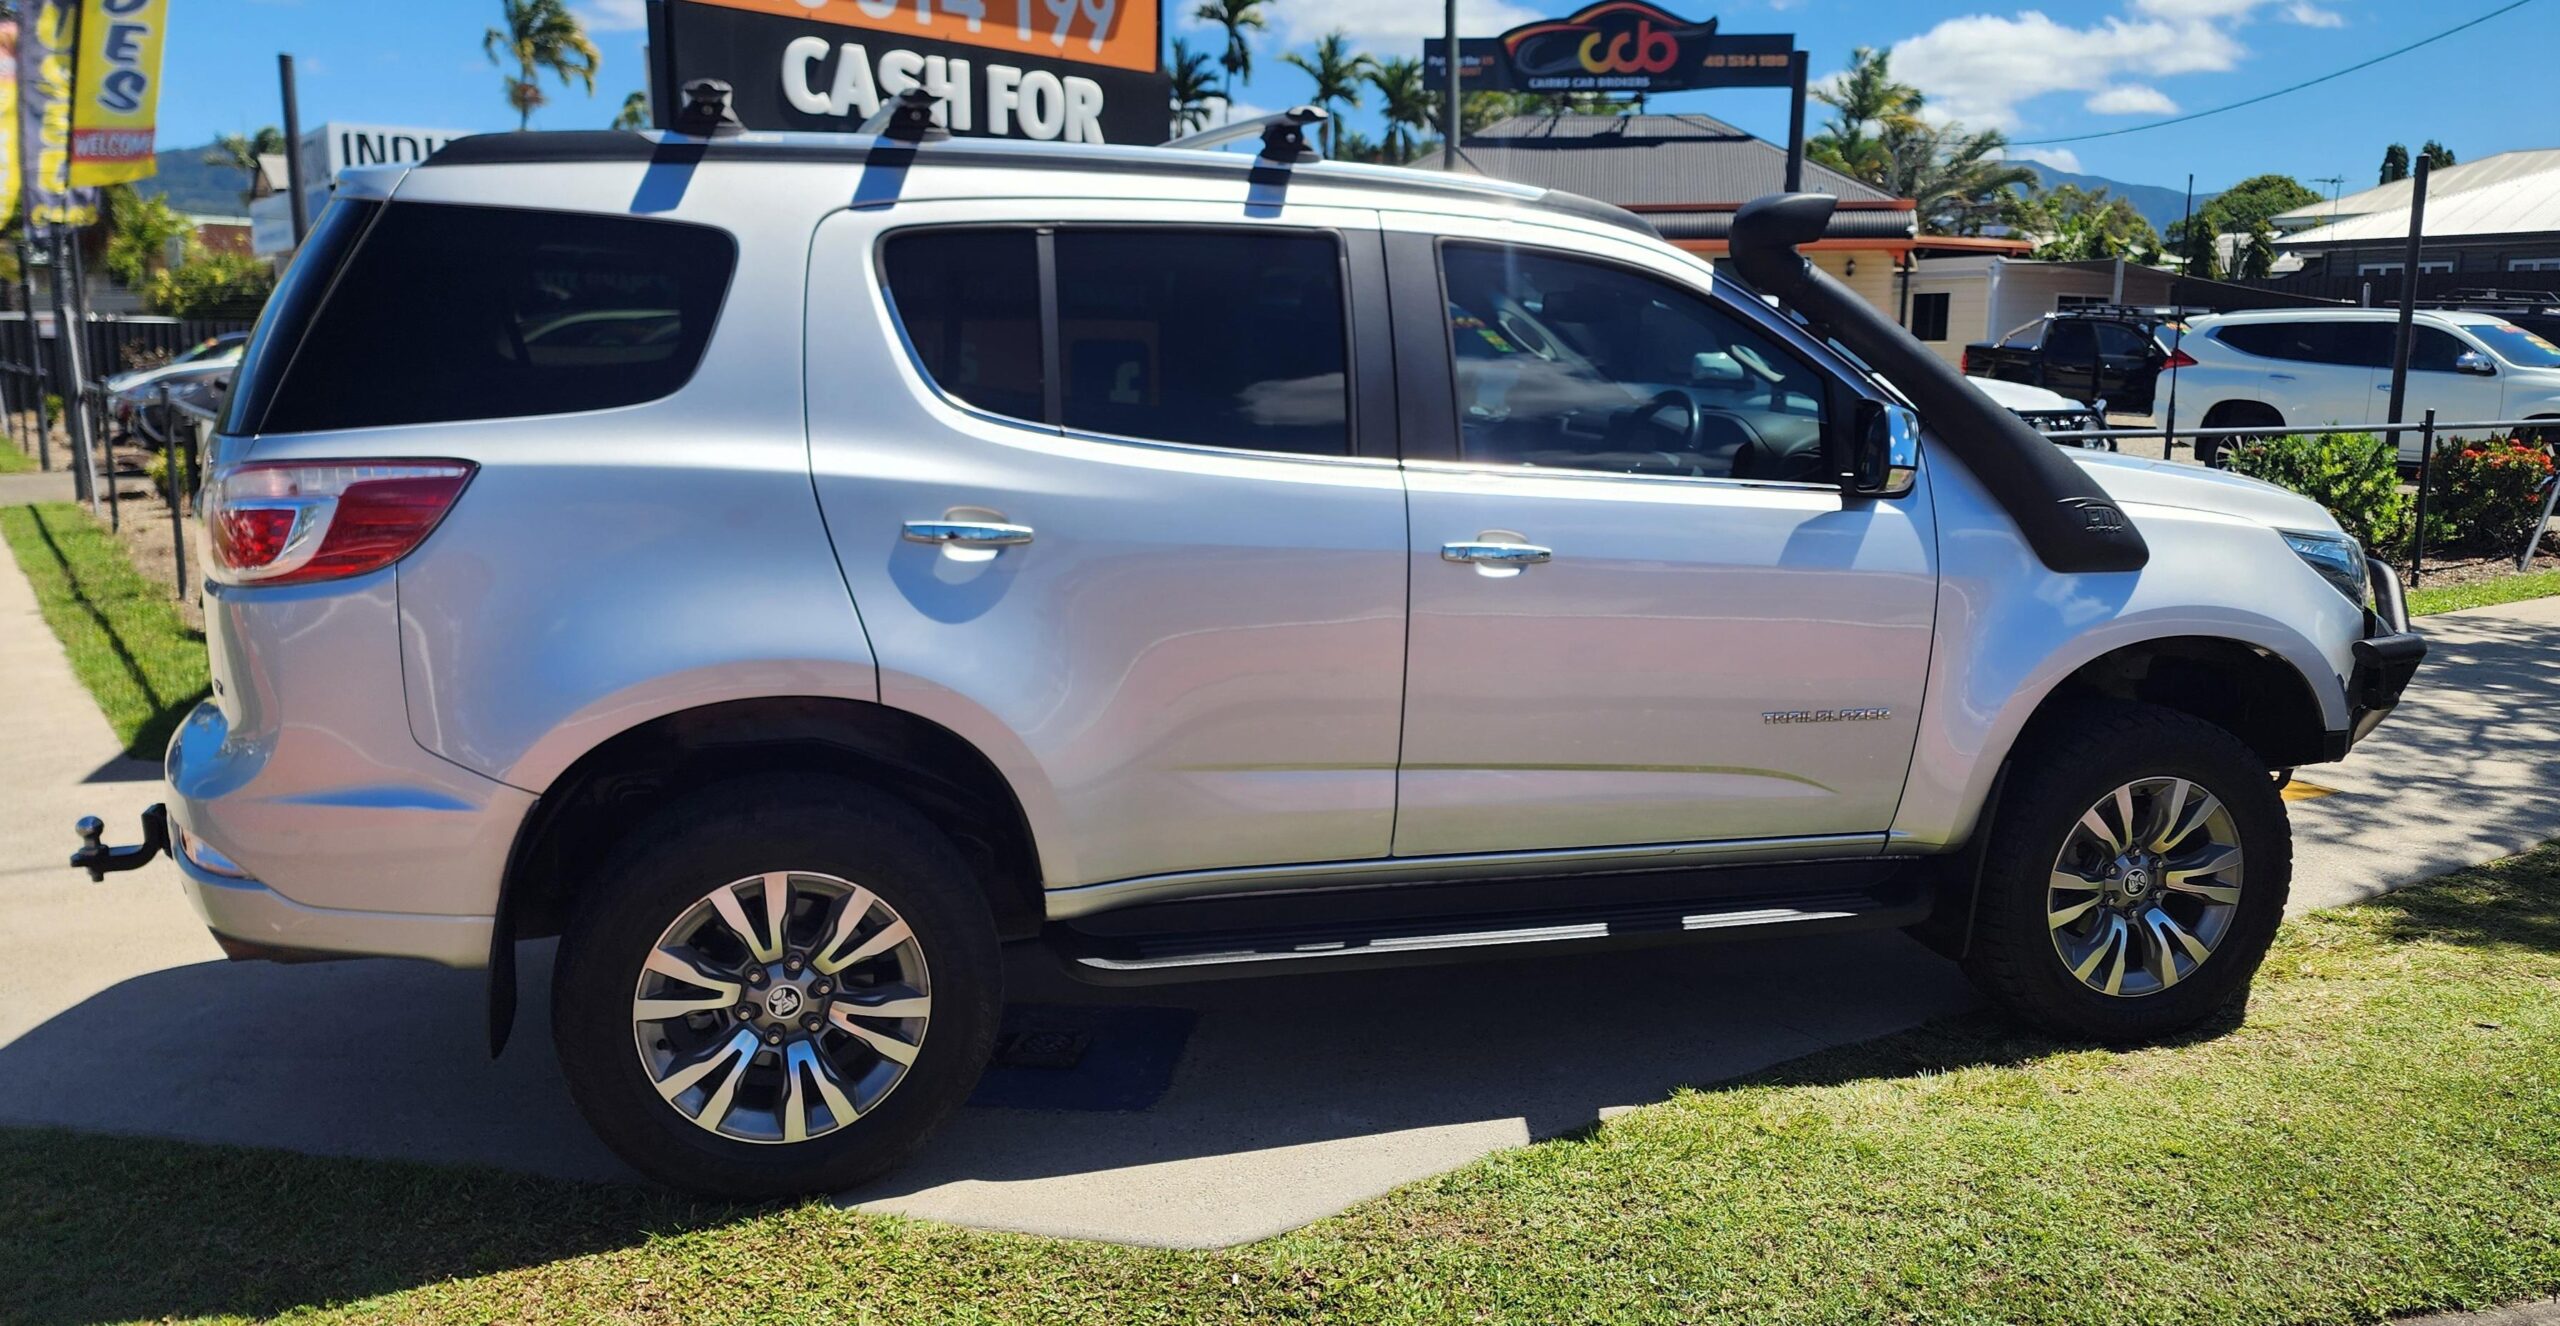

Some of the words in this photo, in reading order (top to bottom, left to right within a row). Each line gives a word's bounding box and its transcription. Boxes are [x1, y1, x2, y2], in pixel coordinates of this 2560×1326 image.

[781, 36, 971, 131] CASH
[986, 64, 1105, 144] FOR
[1528, 77, 1570, 88] CAIRNS
[1572, 77, 1595, 88] CAR
[1597, 76, 1650, 88] BROKERS
[1762, 707, 1891, 725] TRAILBLAZER
